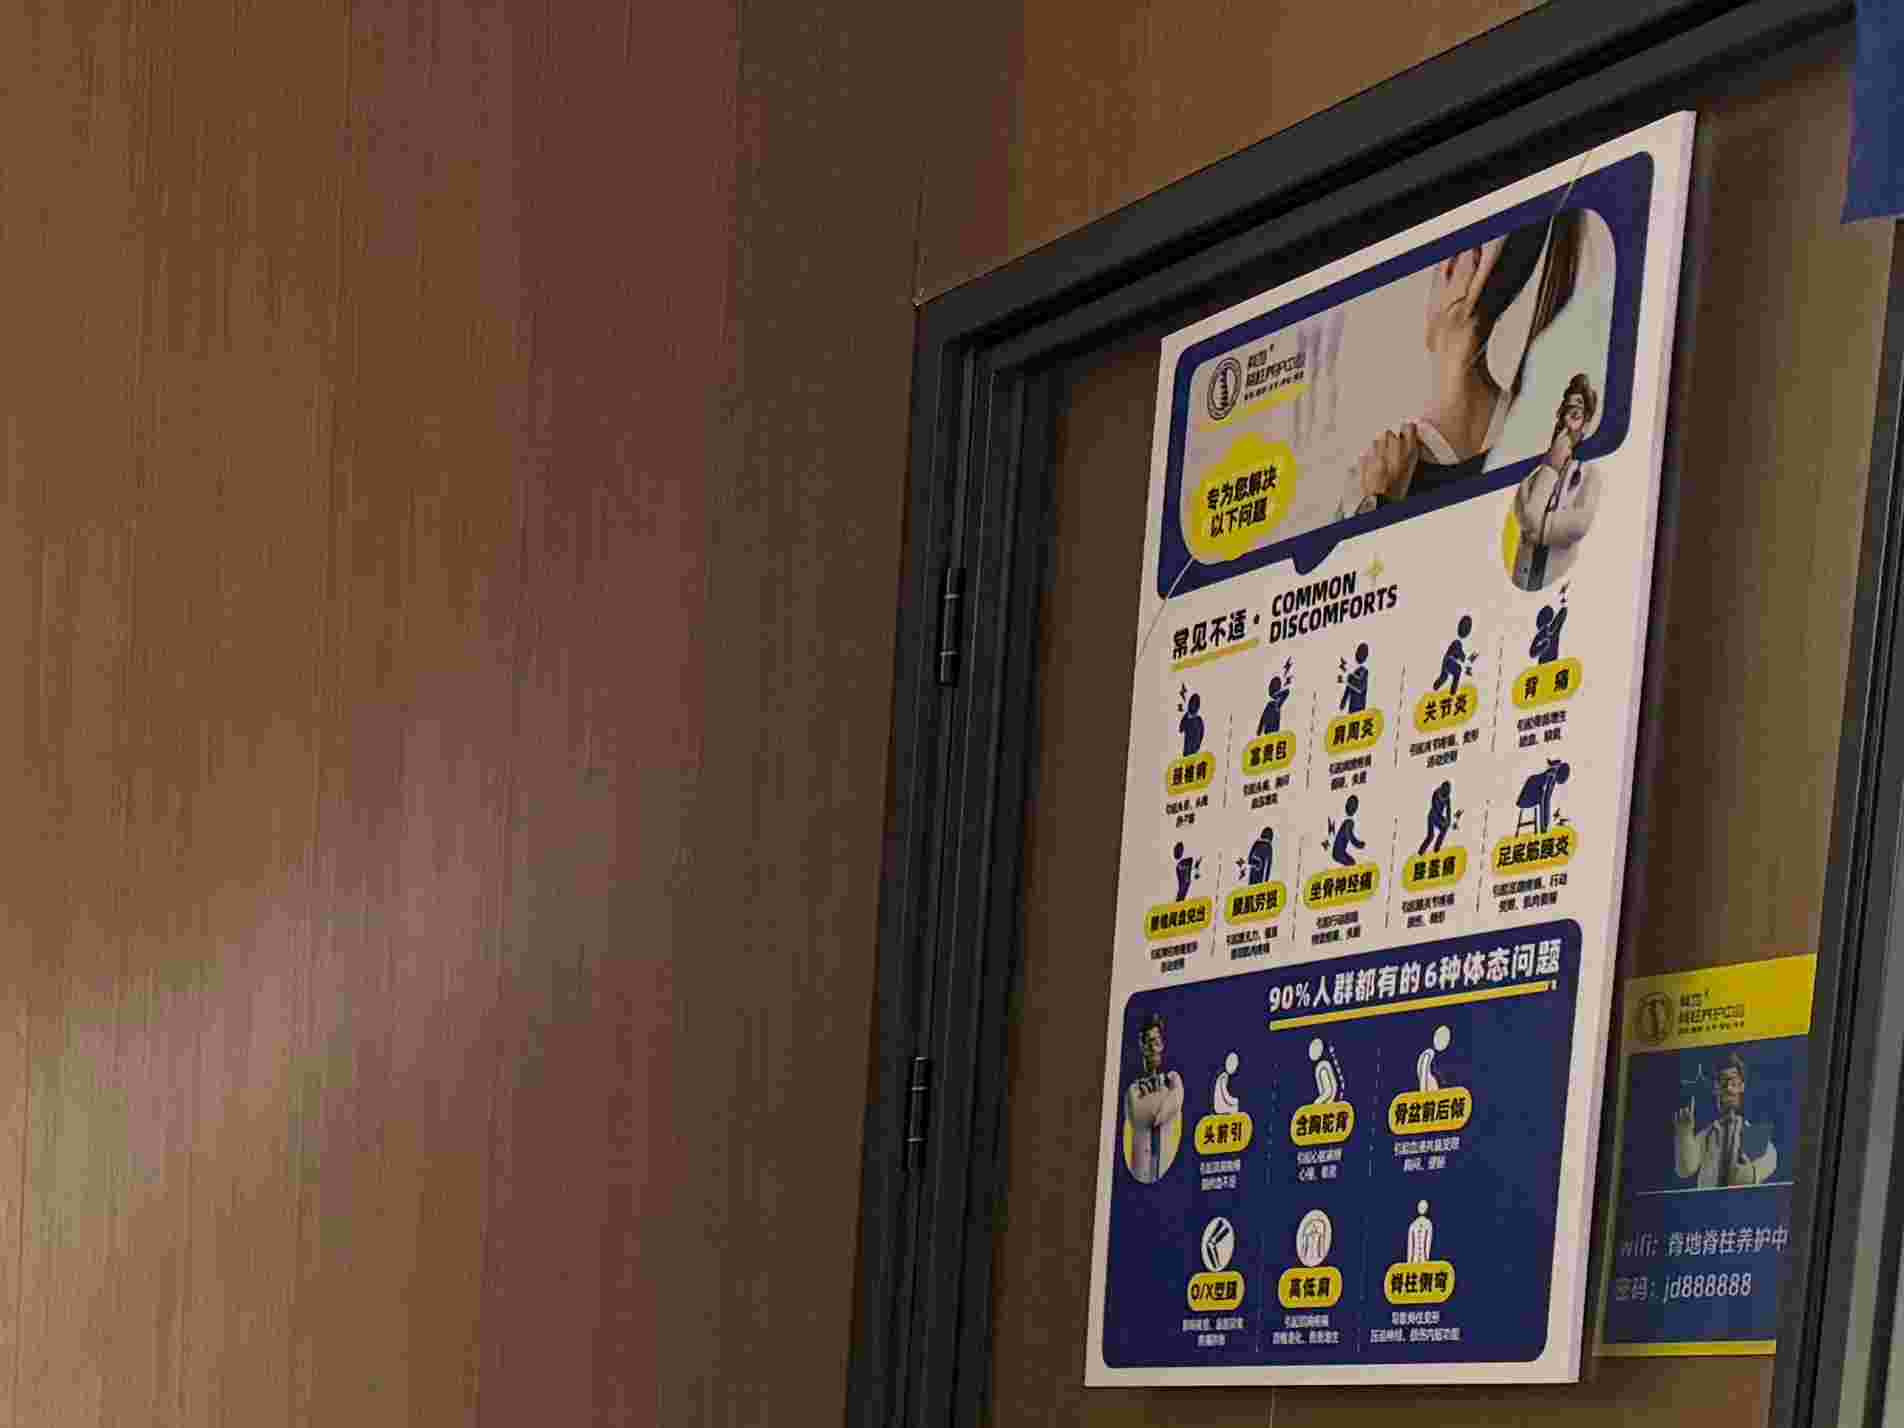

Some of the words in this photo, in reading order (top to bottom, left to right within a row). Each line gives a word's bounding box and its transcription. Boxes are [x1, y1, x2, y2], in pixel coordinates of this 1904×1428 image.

[1207, 463, 1278, 510] 专为您解决
[1210, 496, 1268, 538] 以下问题
[1271, 571, 1357, 618] COMMON
[1269, 584, 1398, 644] DISCOMFORTS
[1172, 607, 1248, 660] 常见不适
[1423, 693, 1469, 724] 关节炎
[1268, 938, 1562, 1013] 90%人群都有的6种体态问题
[1295, 1111, 1350, 1138] 含胸驼背
[1394, 1096, 1467, 1126] 骨盆前后倾
[1203, 1120, 1243, 1146] 头前引
[1288, 1276, 1332, 1300] 高低肩
[1391, 1271, 1449, 1296] 脊柱侧弯
[1663, 1271, 1752, 1304] jd888888
